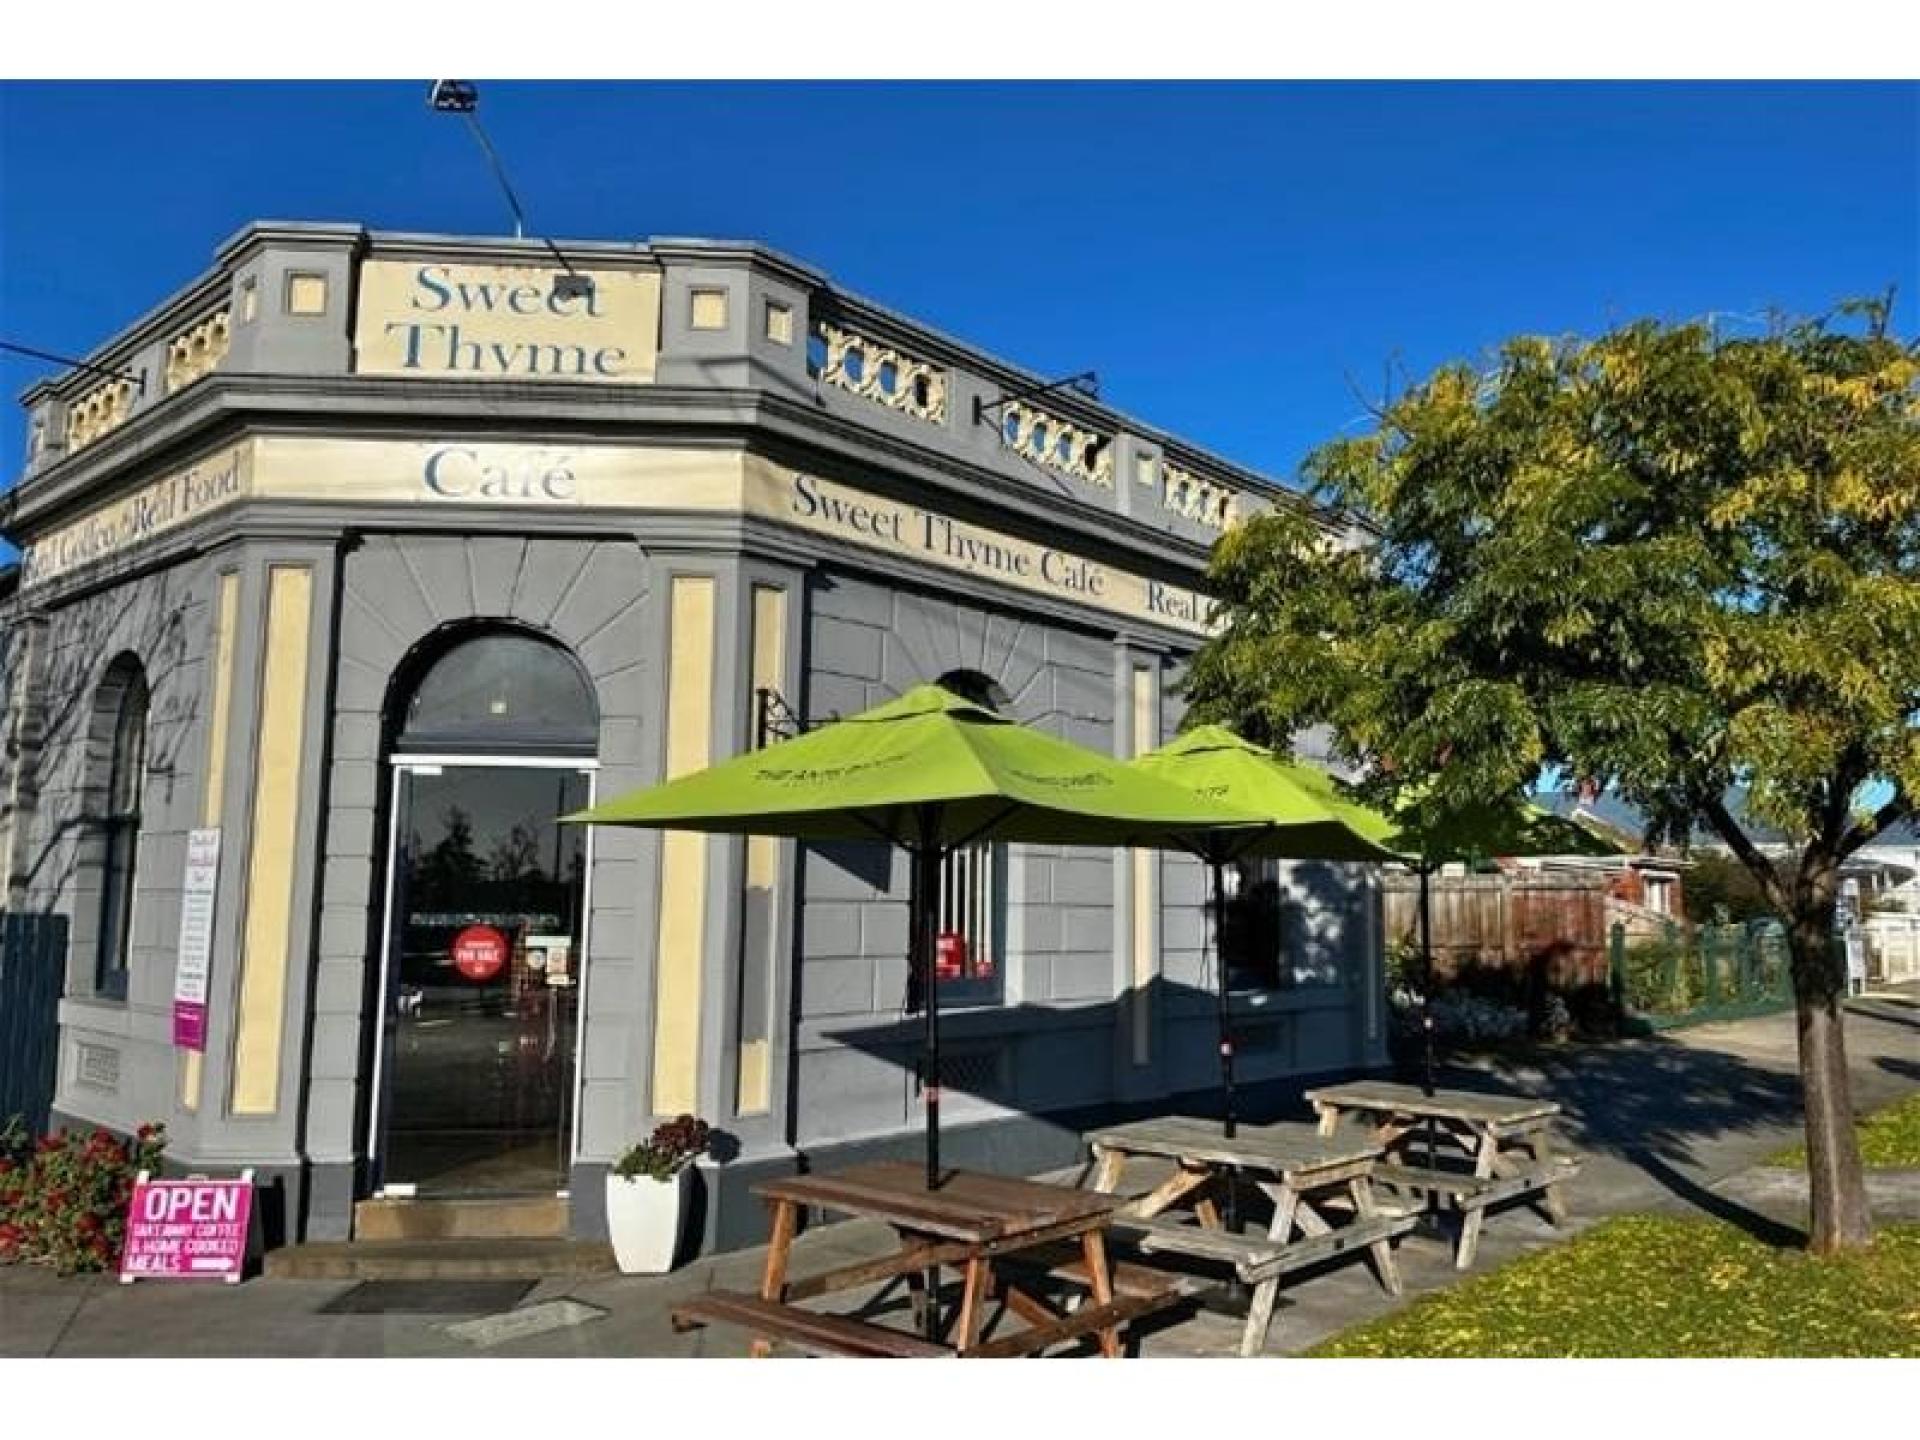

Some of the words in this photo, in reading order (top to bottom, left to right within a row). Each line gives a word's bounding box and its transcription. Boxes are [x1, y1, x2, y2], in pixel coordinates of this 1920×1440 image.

[385, 321, 627, 374] Thyme
[182, 449, 240, 513] Food
[423, 444, 577, 501] Café
[791, 474, 904, 543] Sweet
[912, 508, 1033, 576] Thyme
[1040, 548, 1106, 597] Café
[1147, 579, 1196, 622] Real
[144, 1186, 241, 1221] OPEN
